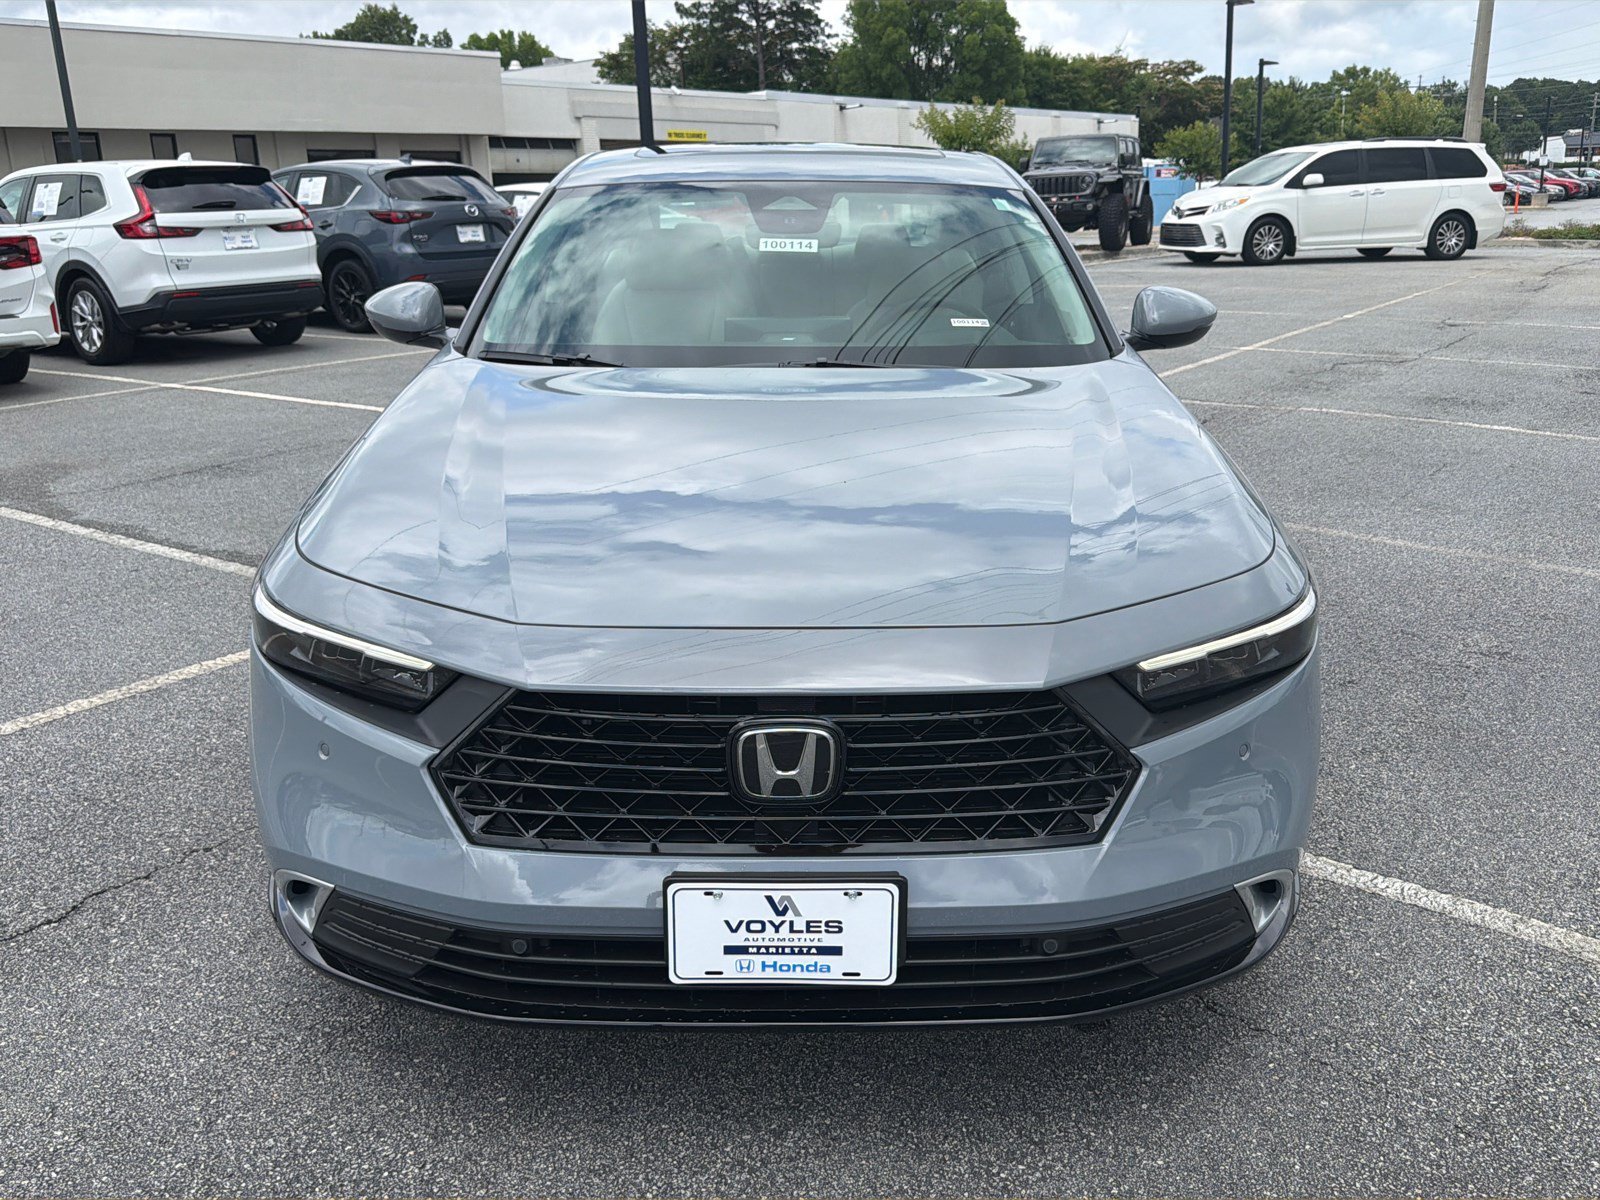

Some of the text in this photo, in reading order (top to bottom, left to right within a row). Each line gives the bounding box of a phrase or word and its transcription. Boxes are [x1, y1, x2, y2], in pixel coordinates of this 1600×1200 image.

[761, 239, 813, 250] 100114
[723, 919, 844, 934] VOYLES
[747, 947, 818, 955] MARIETTA
[760, 960, 831, 974] Honda
